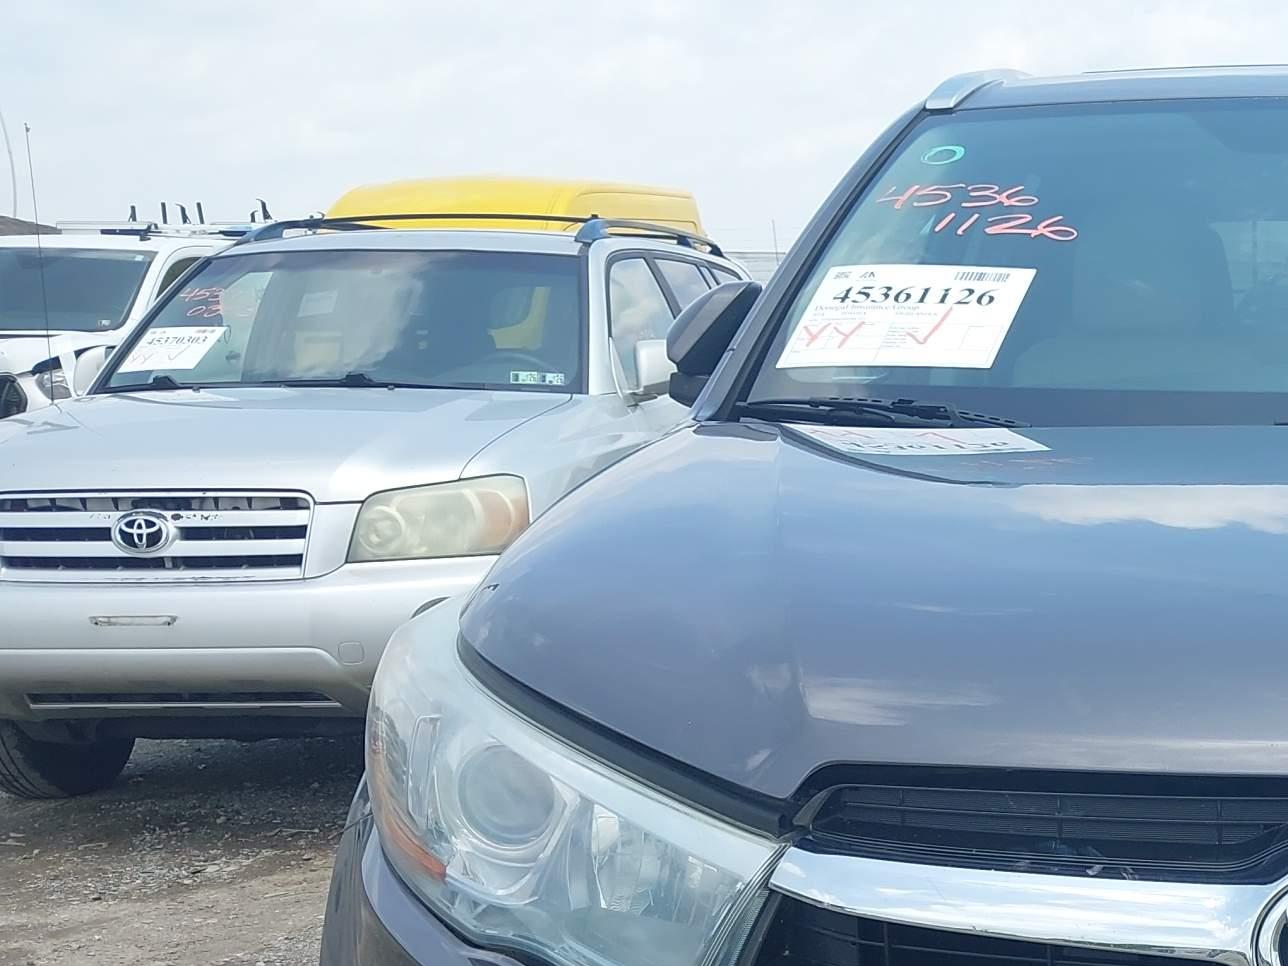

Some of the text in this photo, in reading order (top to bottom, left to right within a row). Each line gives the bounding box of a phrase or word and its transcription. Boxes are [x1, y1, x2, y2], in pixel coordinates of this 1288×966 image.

[876, 183, 1040, 210] 4536
[933, 212, 1079, 241] 1126
[831, 285, 1001, 306] 45361126
[146, 335, 209, 346] 45370303
